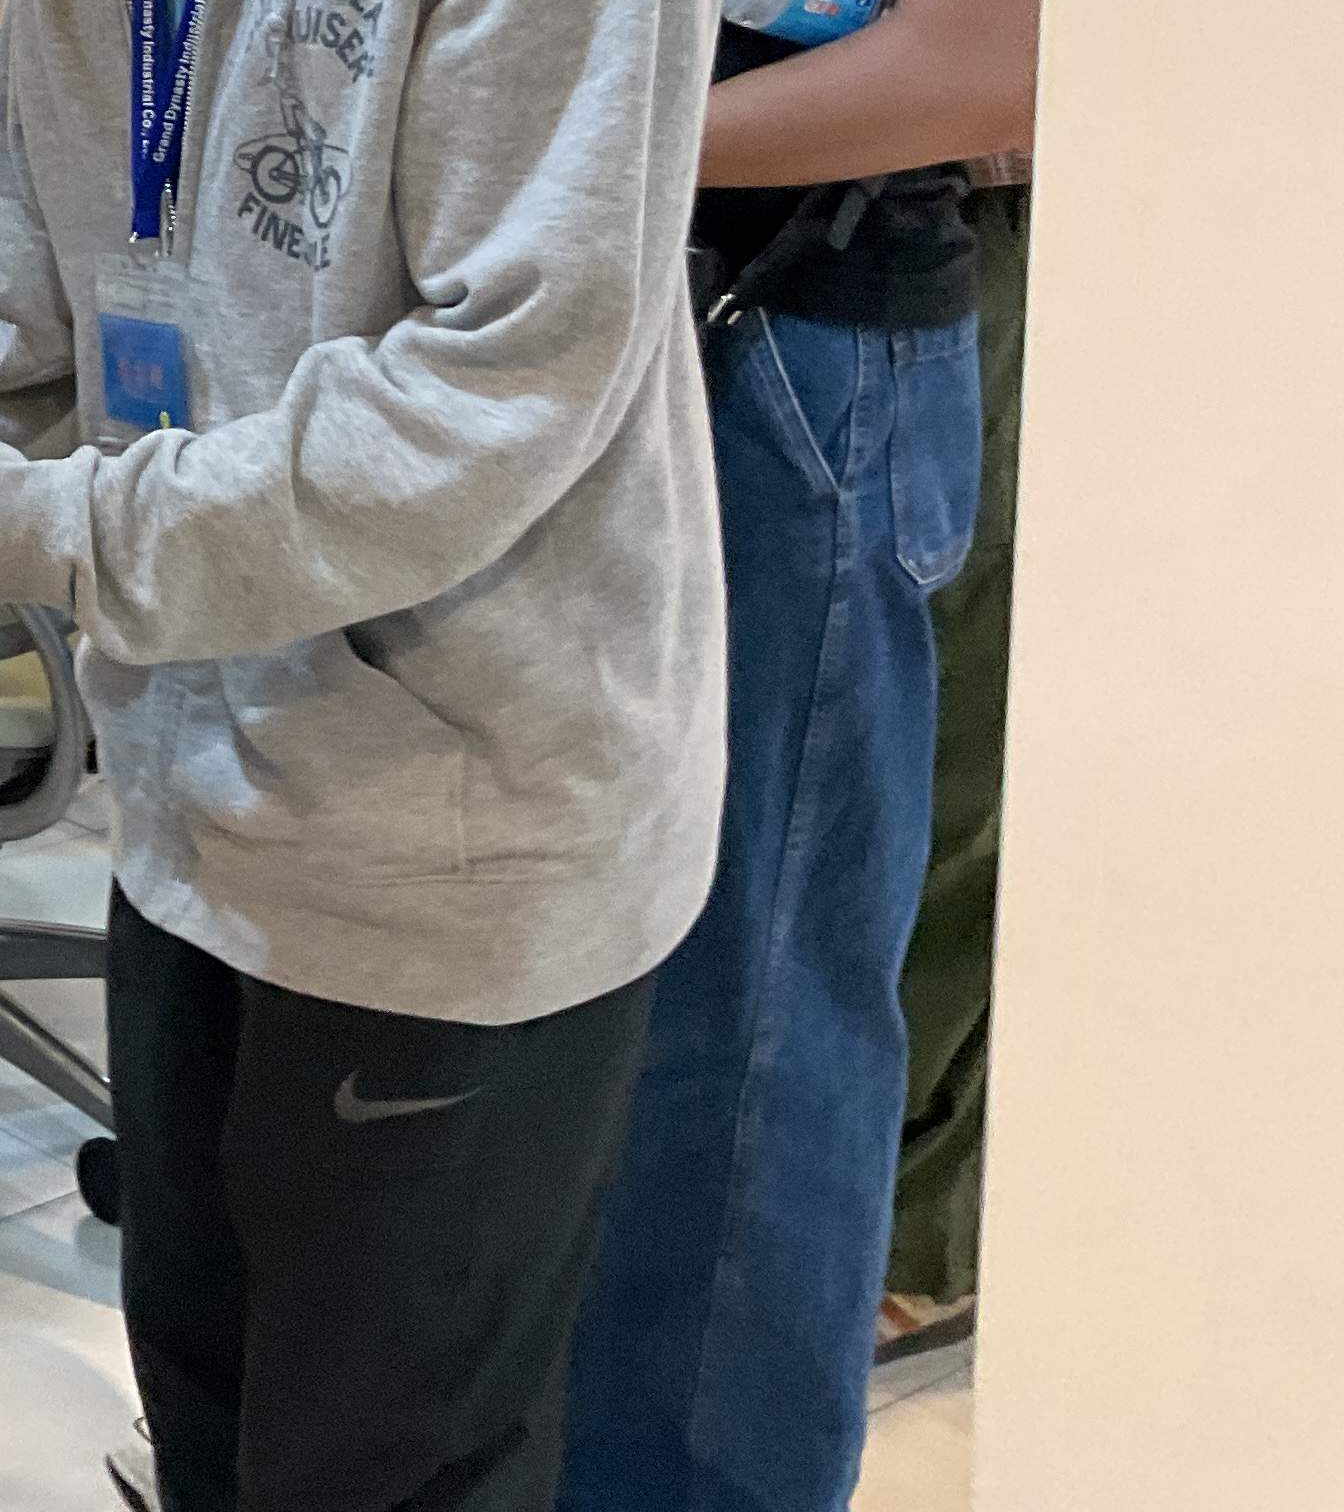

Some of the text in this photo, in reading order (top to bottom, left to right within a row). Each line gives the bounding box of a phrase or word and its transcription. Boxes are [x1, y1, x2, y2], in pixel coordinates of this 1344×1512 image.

[142, 41, 155, 107] Industrial
[164, 66, 191, 118] Dynasty
[153, 121, 176, 164] Grand
